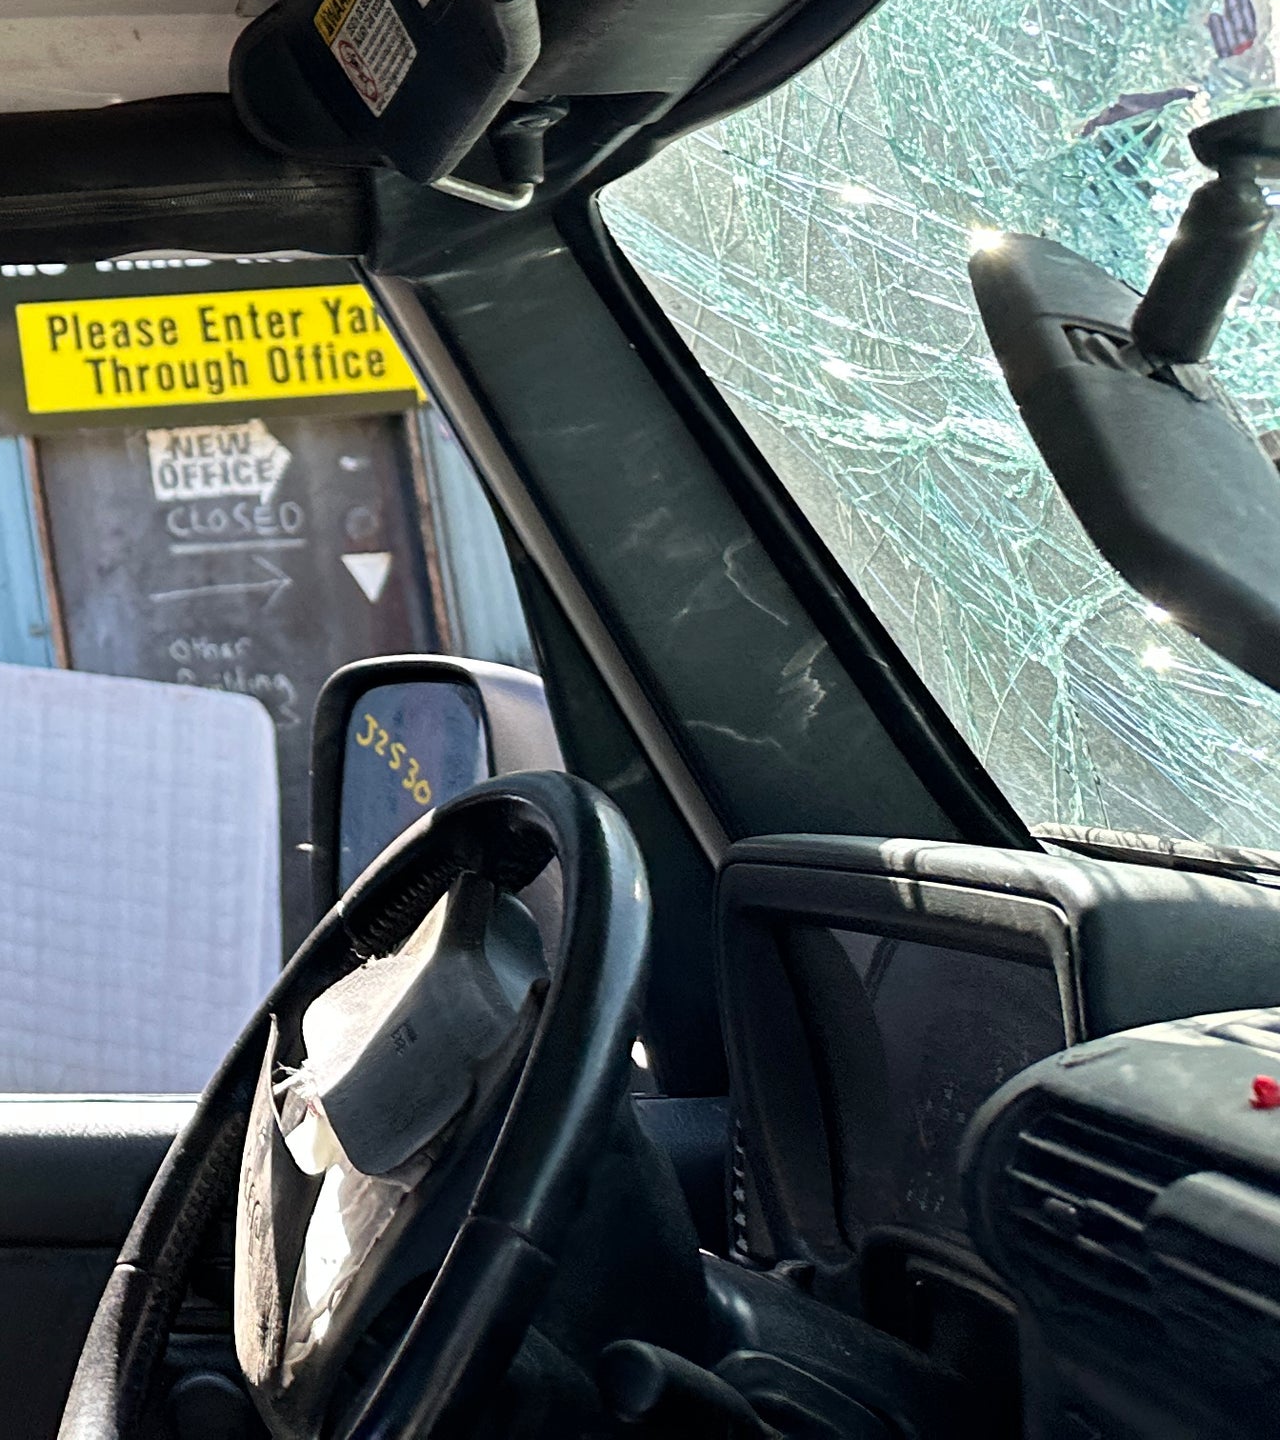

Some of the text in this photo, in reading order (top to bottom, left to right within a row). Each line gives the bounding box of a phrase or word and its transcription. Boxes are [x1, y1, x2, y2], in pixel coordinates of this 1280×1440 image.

[47, 313, 178, 351] Please
[198, 301, 303, 342] Enter
[84, 342, 386, 395] Through Office
[169, 432, 250, 460] NEW
[158, 457, 273, 490] OFFICE
[167, 501, 305, 537] CLOSED
